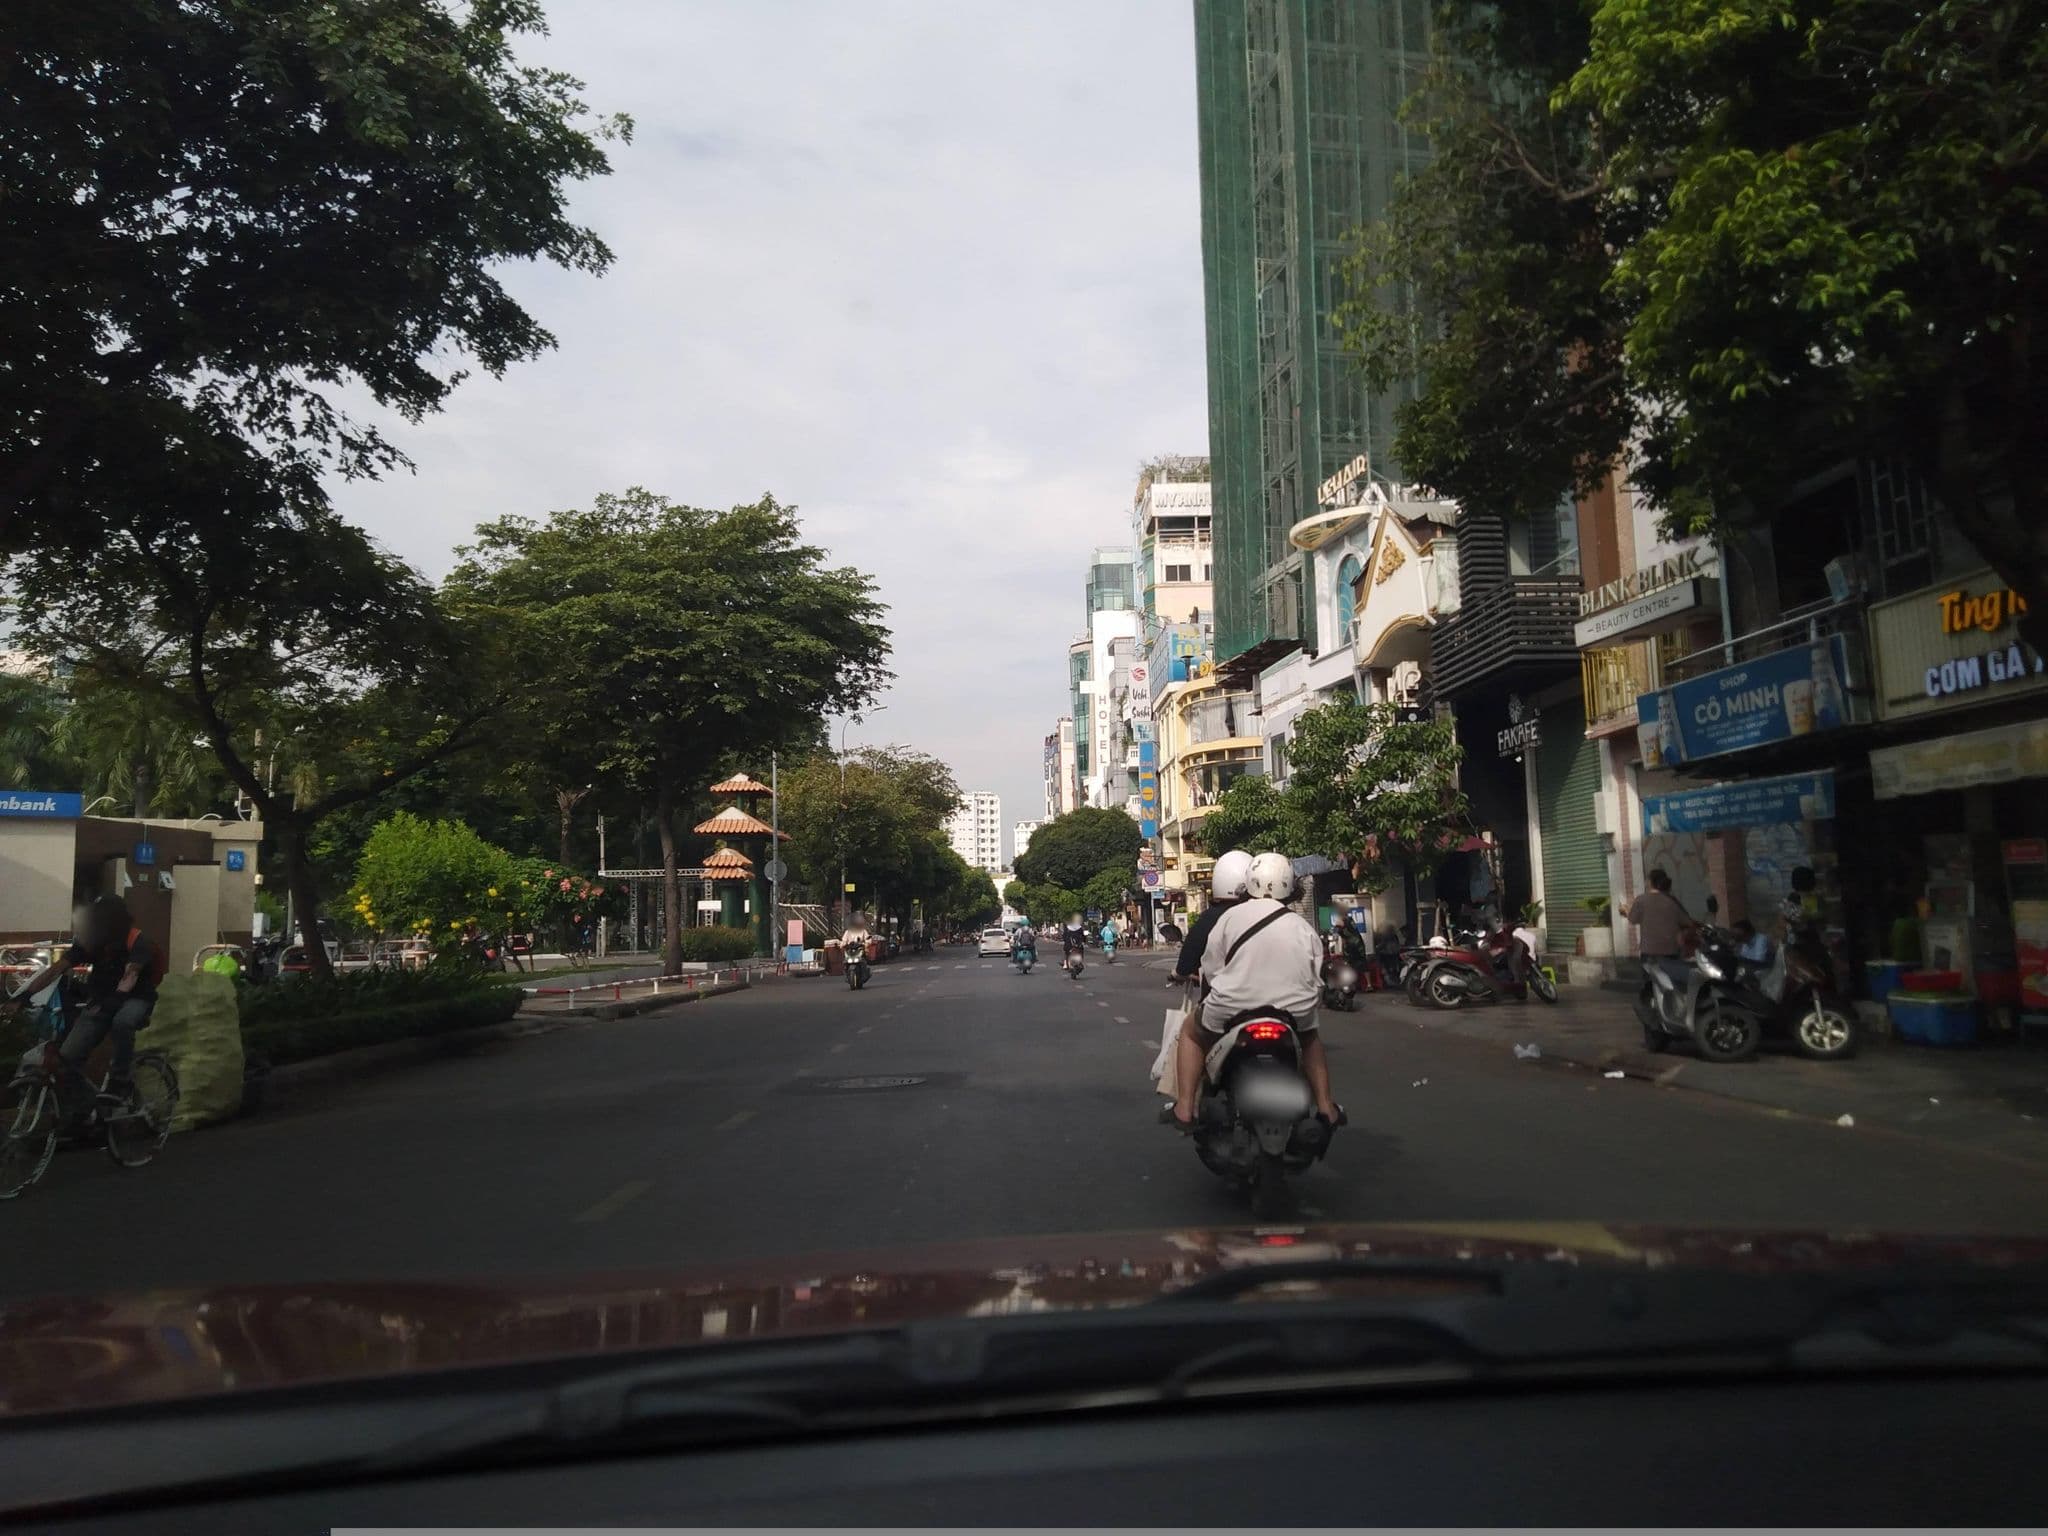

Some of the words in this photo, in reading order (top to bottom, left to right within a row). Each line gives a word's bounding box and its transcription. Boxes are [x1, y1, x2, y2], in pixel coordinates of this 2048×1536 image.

[1579, 572, 1637, 617] BLINK
[1638, 546, 1701, 594] BLINK
[1595, 611, 1630, 633] BEAUTY
[1632, 597, 1671, 619] CENTRE
[1719, 672, 1748, 691] SHOP
[1131, 706, 1150, 718] Sushi
[1694, 696, 1722, 724] CÔ
[1726, 683, 1780, 717] MINH
[1098, 695, 1107, 764] HOTEL
